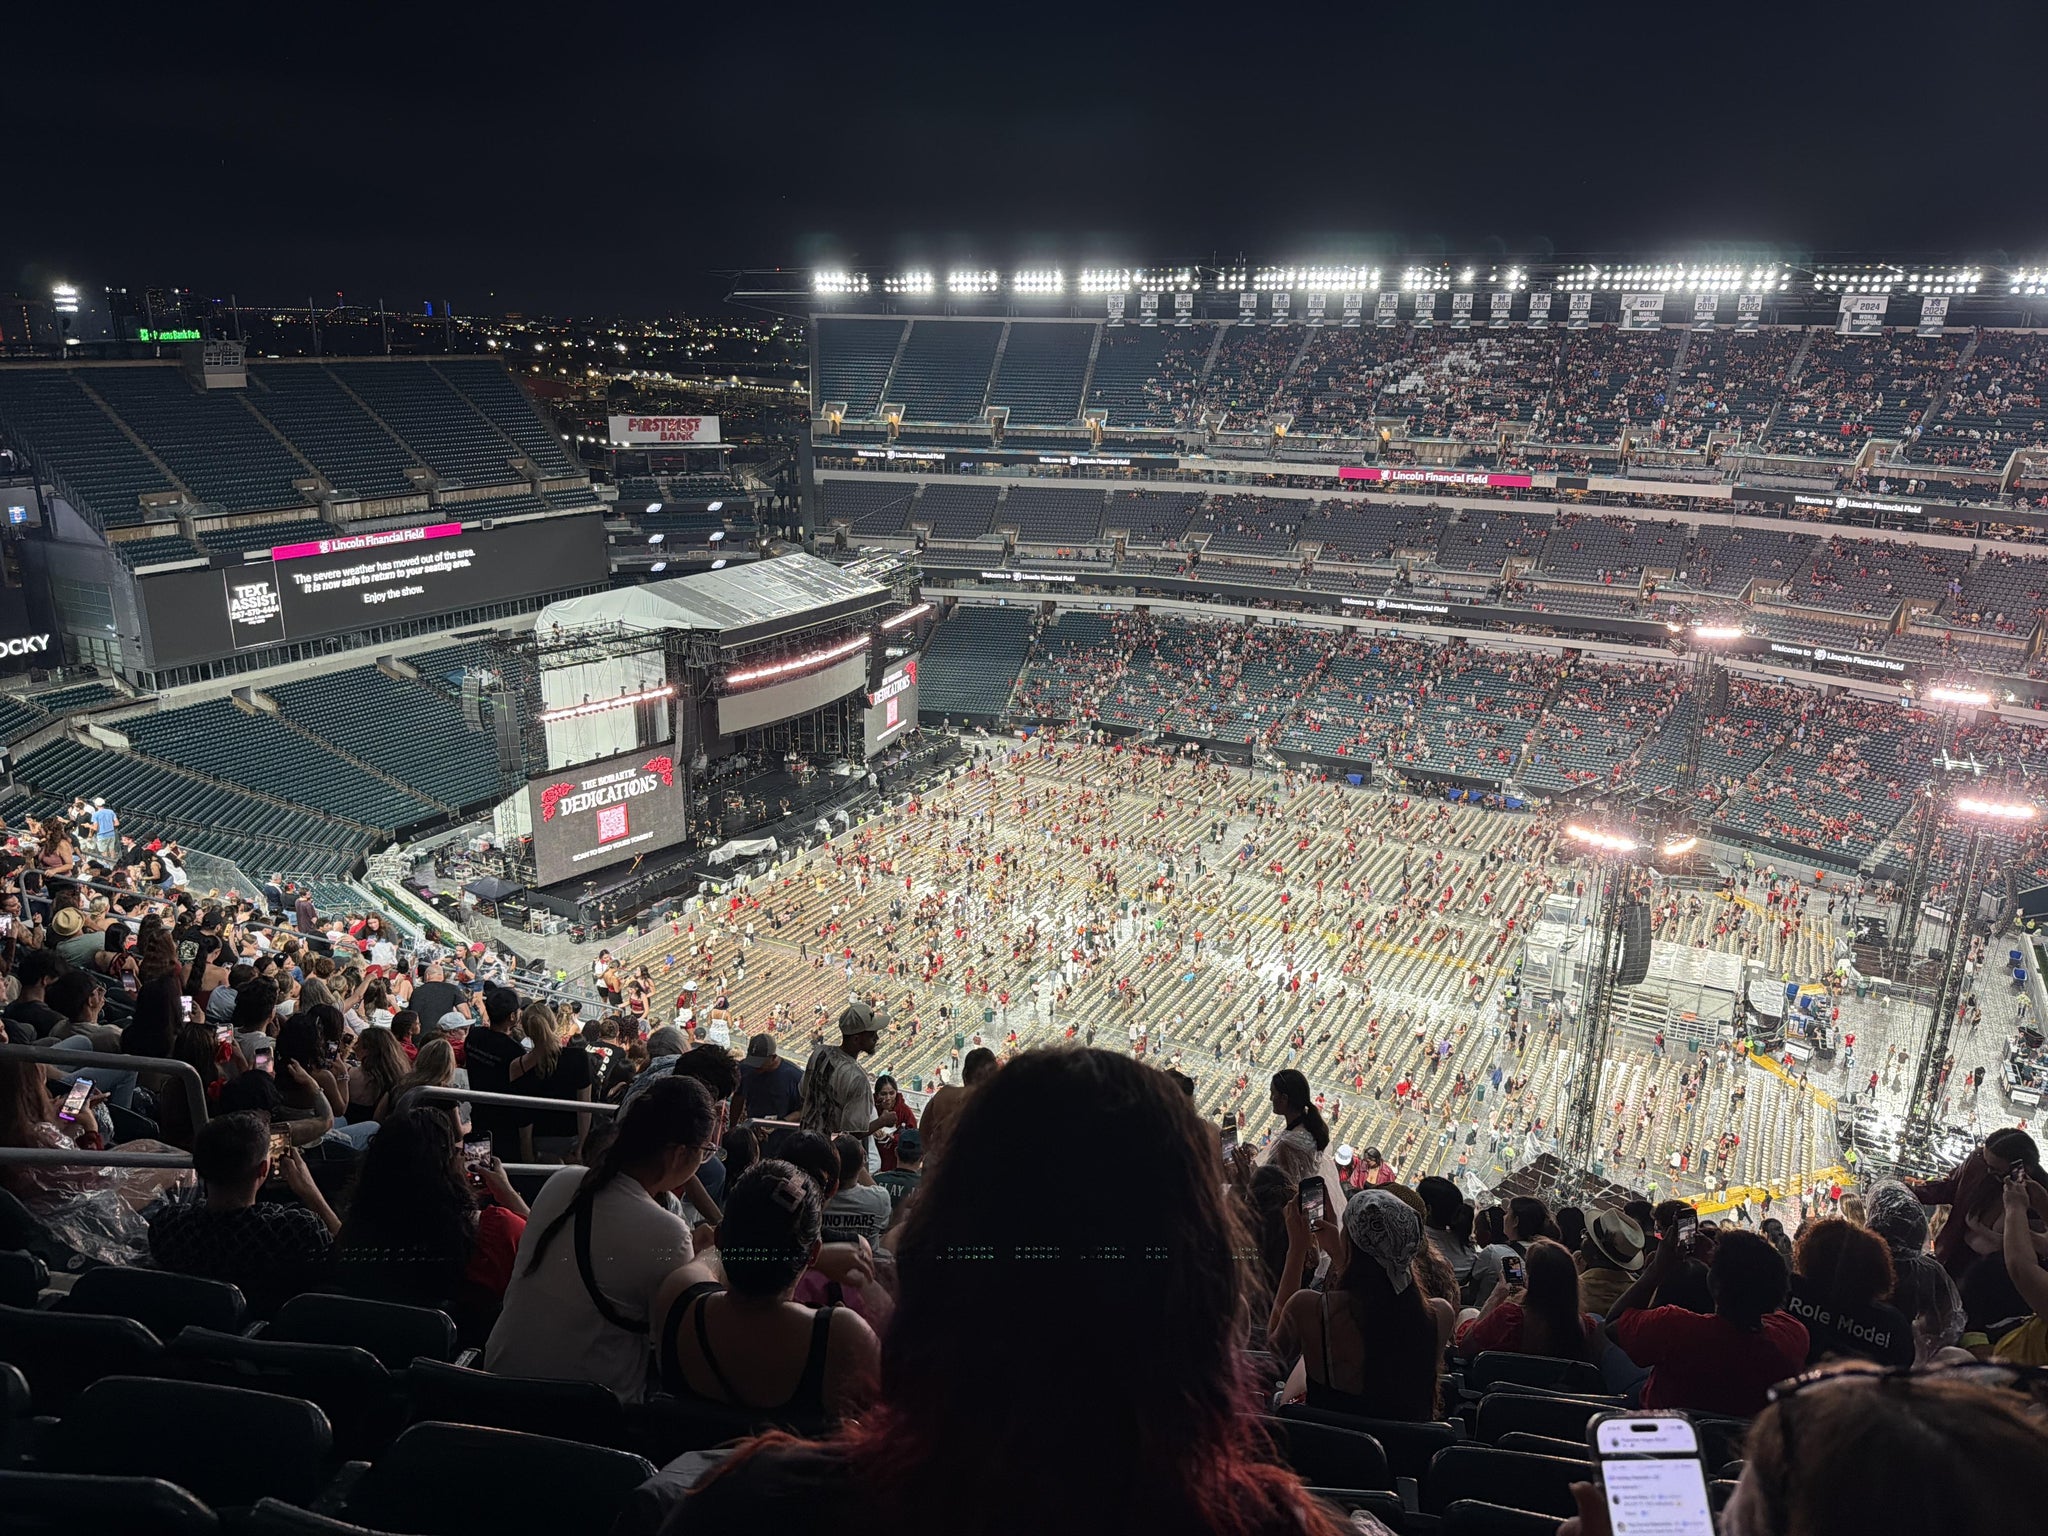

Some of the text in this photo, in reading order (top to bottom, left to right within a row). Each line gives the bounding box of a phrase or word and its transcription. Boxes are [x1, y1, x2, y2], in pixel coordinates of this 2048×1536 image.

[1640, 300, 1658, 308] 2017
[1698, 302, 1715, 310] 2019
[1860, 302, 1880, 310] 2024
[660, 432, 694, 441] BANK
[1392, 470, 1488, 484] Lincoln Financial Field
[1795, 495, 1825, 505] Welcome
[1848, 500, 1872, 509] Lincoln
[1873, 503, 1903, 512] Financial
[1904, 505, 1922, 514] Field
[332, 528, 424, 550] Lincoln Financial Field
[294, 548, 476, 584] The severe weather has moved out of the area.
[304, 559, 471, 594] It is now safe to return to your seating area.
[235, 582, 269, 598] TEXT
[364, 584, 424, 604] Enjoy the show.
[232, 592, 277, 612] ASSIST
[1771, 644, 1802, 655] Welcome
[1827, 652, 1853, 662] Lincoln
[1853, 656, 1885, 668] Financial
[1886, 661, 1904, 671] Field
[581, 768, 636, 791] THE ROMANTIC
[560, 774, 658, 816] DEDICATIONS
[844, 1214, 876, 1226] MARS
[1788, 1297, 1891, 1348] Role Model
